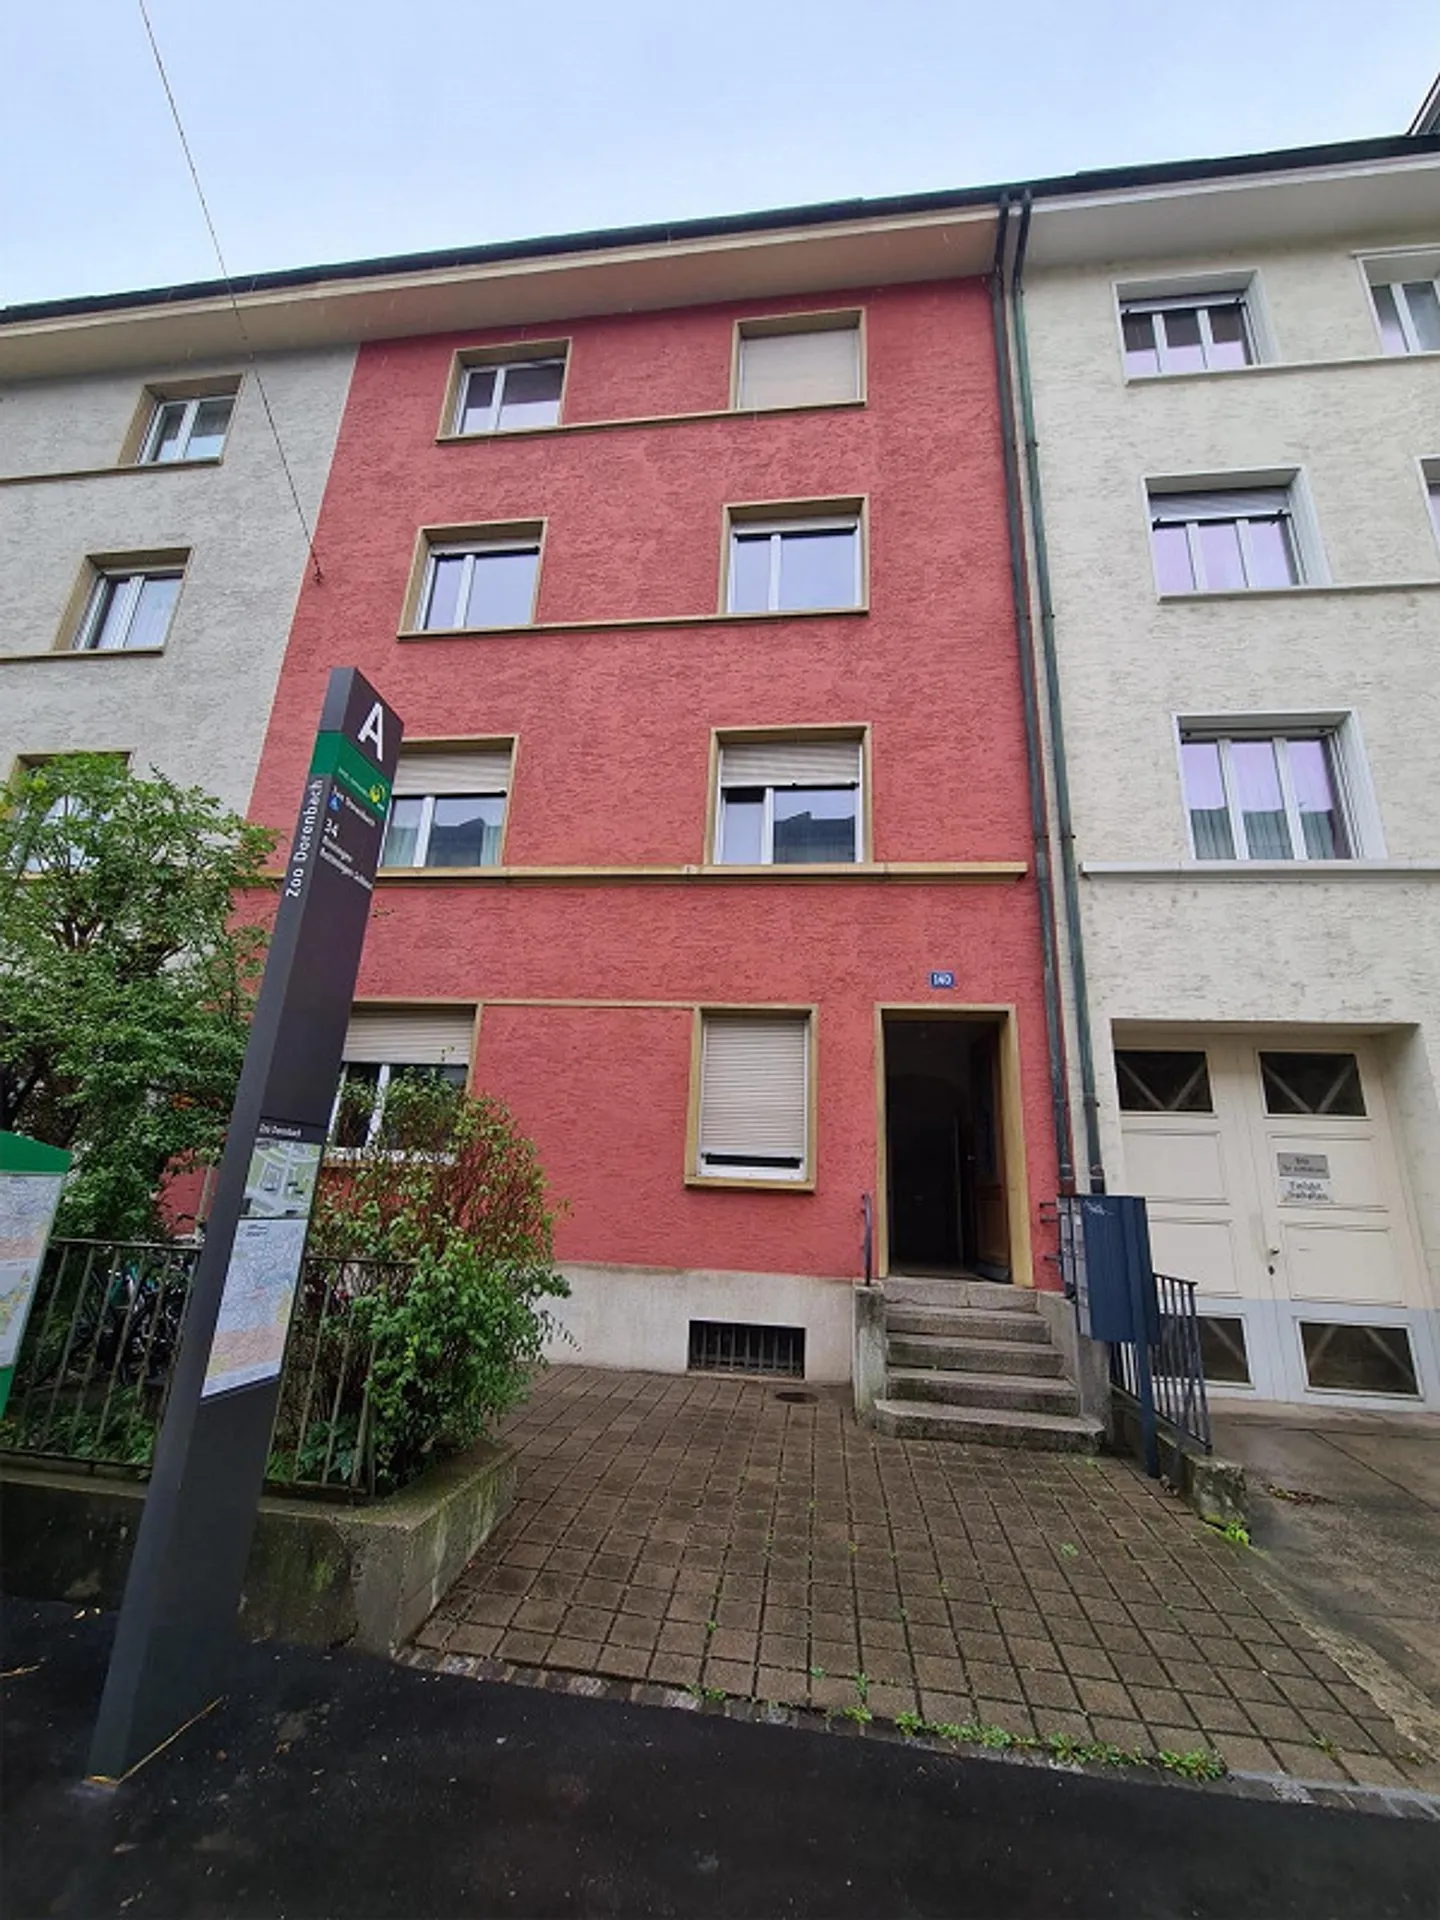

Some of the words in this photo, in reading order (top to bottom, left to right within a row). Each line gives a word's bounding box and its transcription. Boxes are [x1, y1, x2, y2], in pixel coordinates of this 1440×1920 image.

[357, 702, 385, 762] A
[293, 779, 323, 862] Dorenbach
[285, 868, 304, 897] Zoo
